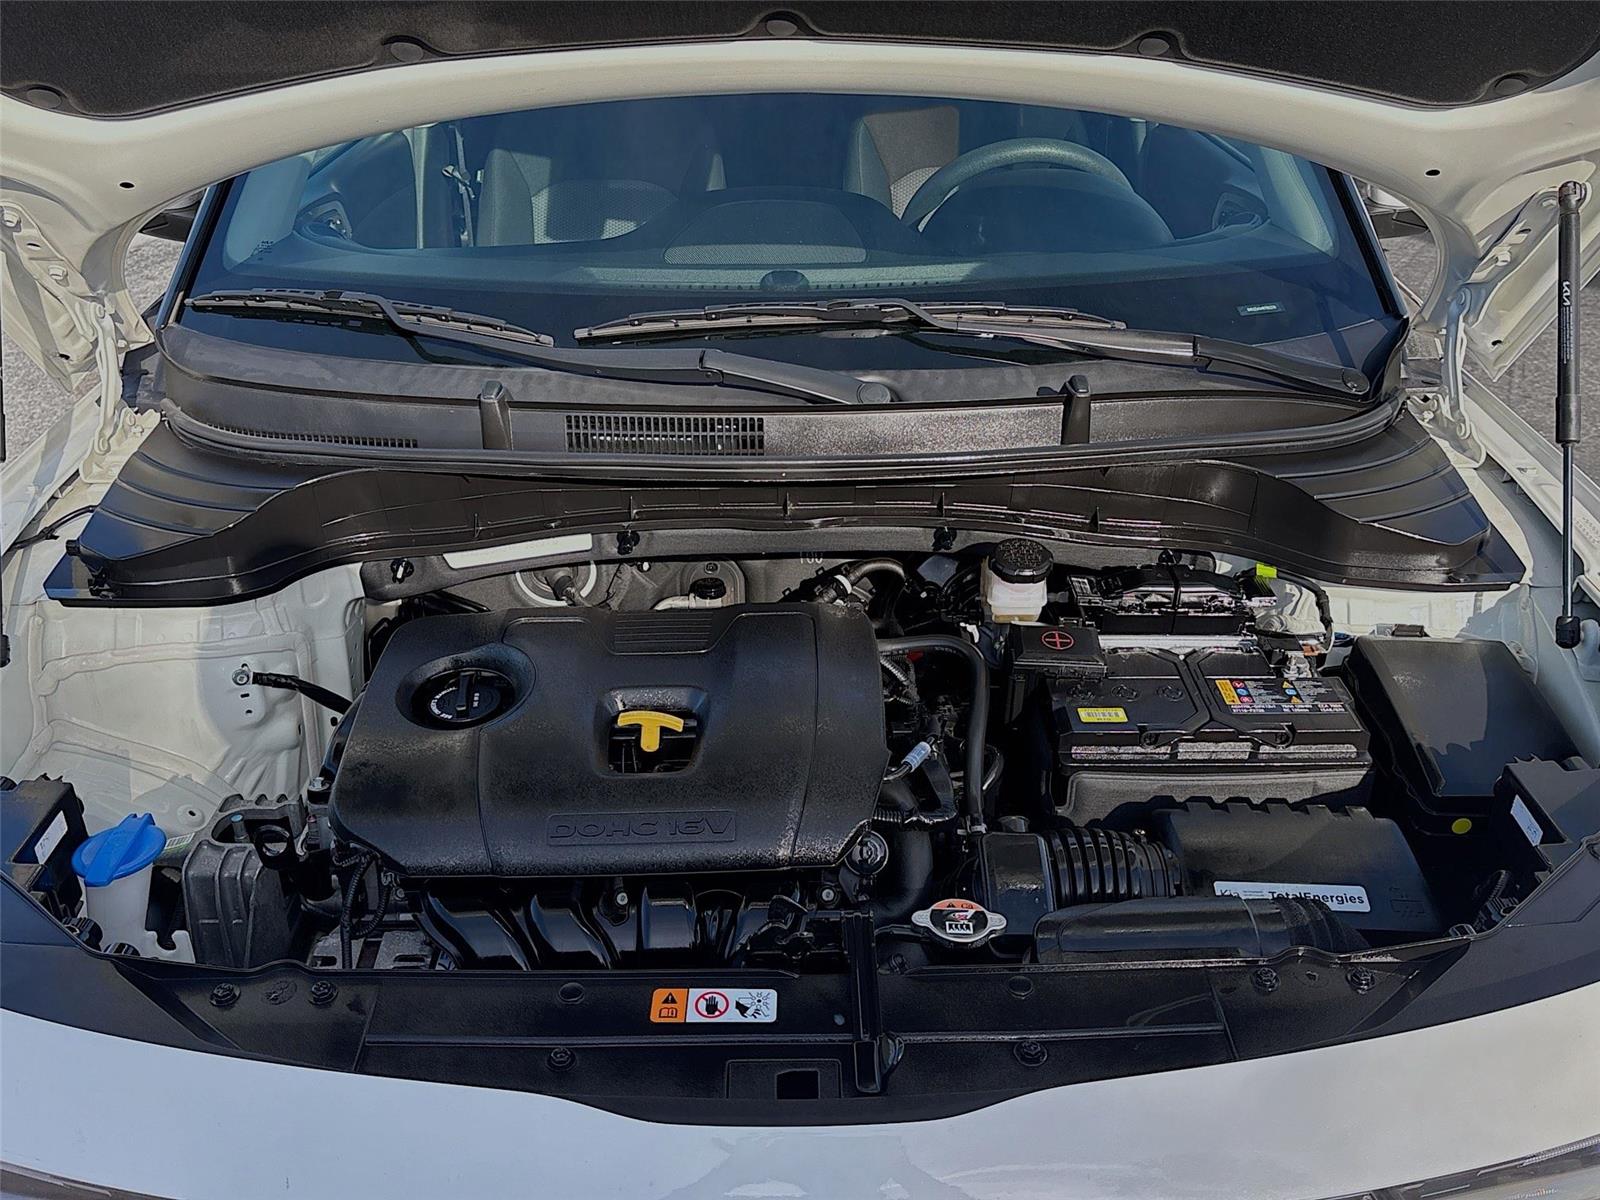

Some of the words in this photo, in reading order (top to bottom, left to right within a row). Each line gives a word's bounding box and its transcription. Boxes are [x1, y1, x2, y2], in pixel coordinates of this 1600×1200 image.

[1562, 280, 1571, 306] KIA
[549, 820, 659, 839] DOHC
[667, 816, 734, 836] 16V
